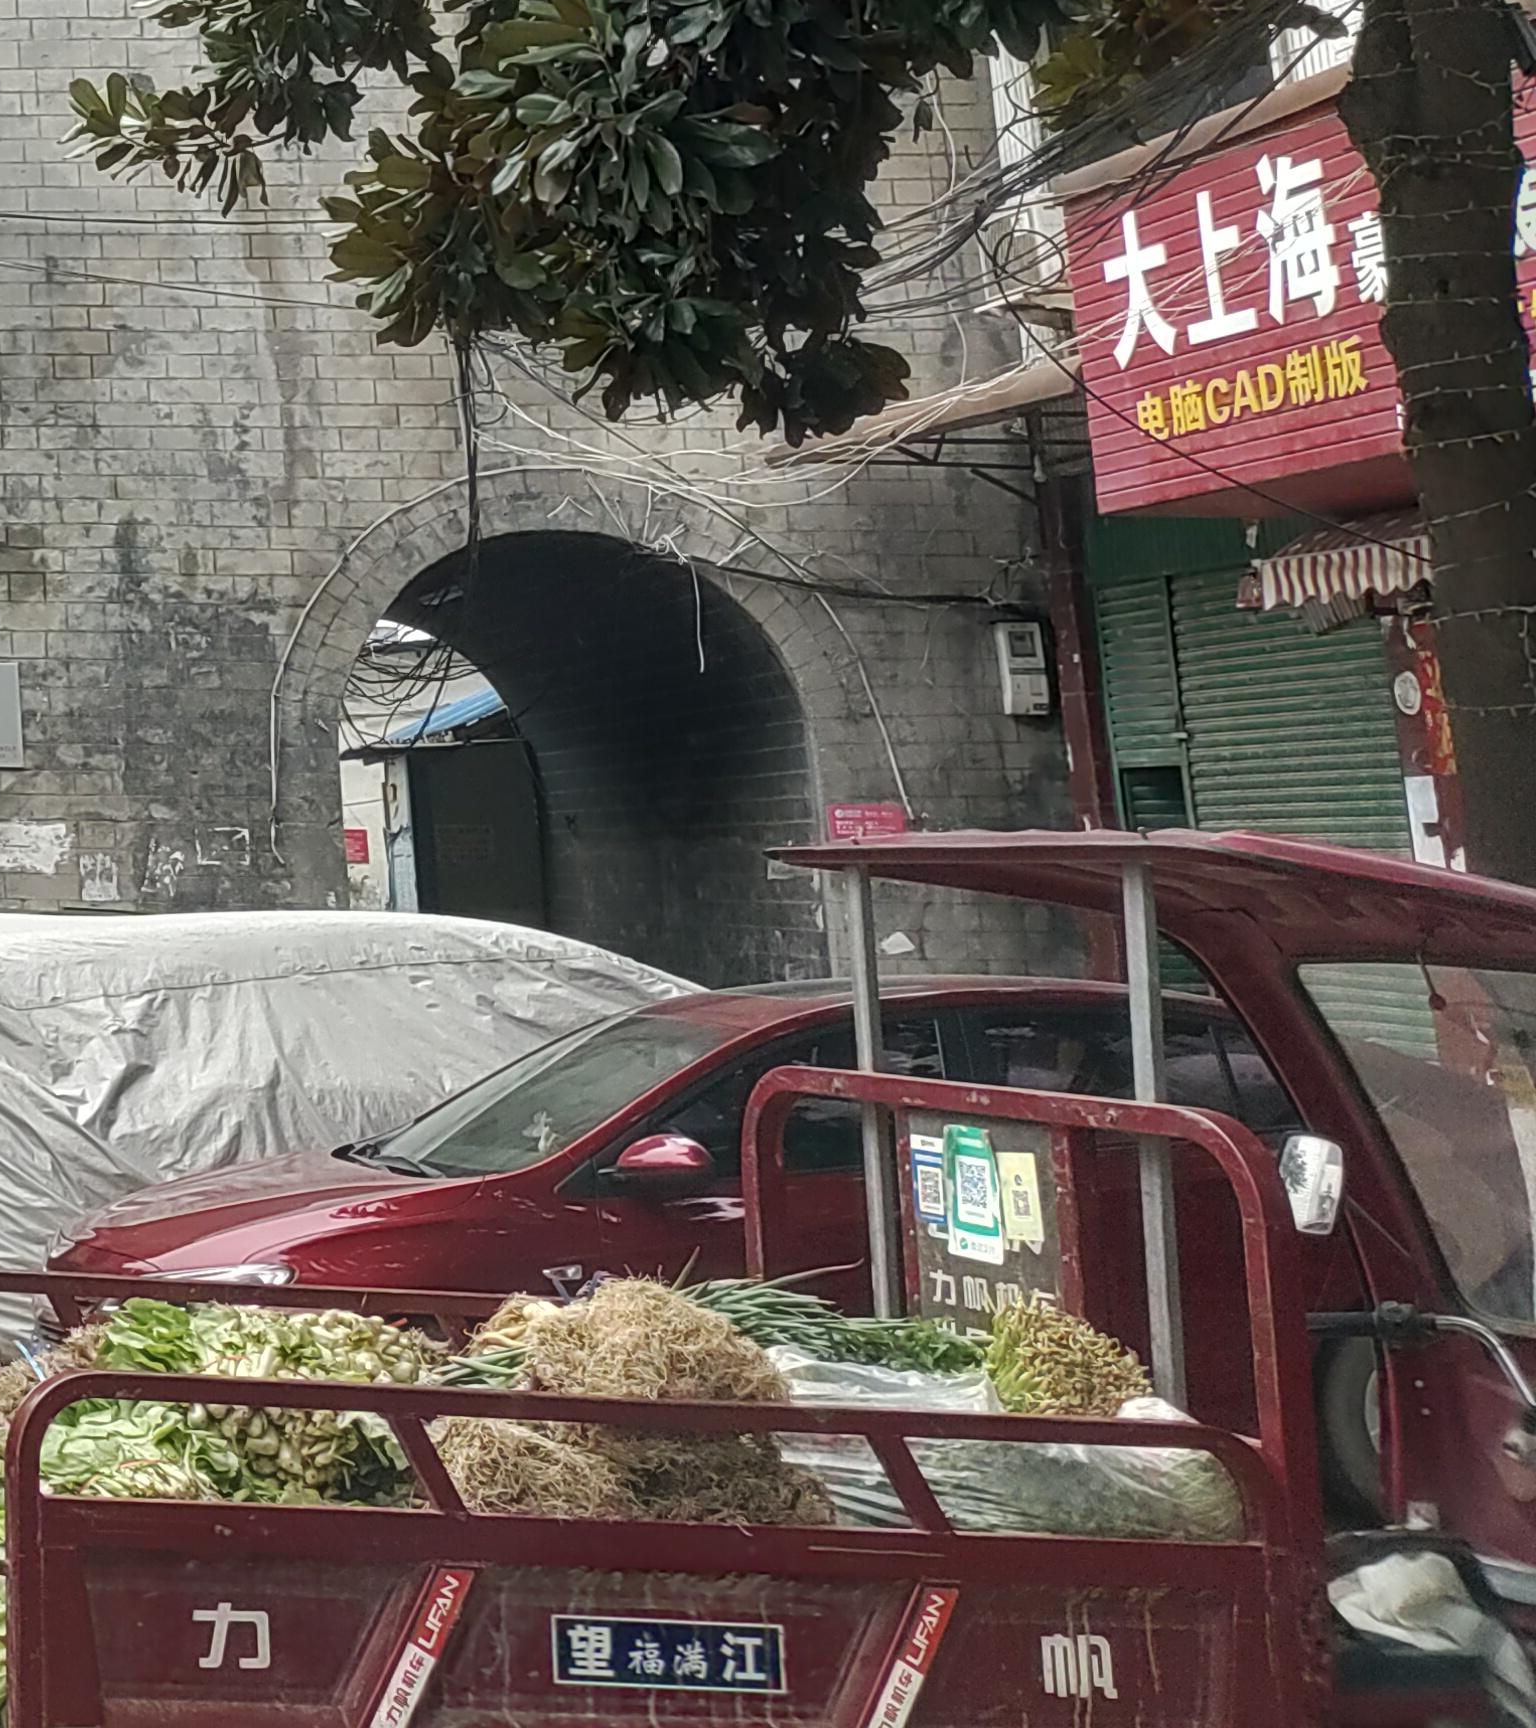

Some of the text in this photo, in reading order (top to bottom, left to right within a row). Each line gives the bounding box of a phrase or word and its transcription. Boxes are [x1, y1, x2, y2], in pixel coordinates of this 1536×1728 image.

[1135, 334, 1370, 442] 电脑CAD制版
[192, 1602, 271, 1669] 力
[386, 1575, 460, 1726] 力帆机车 LIFAN
[905, 1594, 946, 1667] LIFAN
